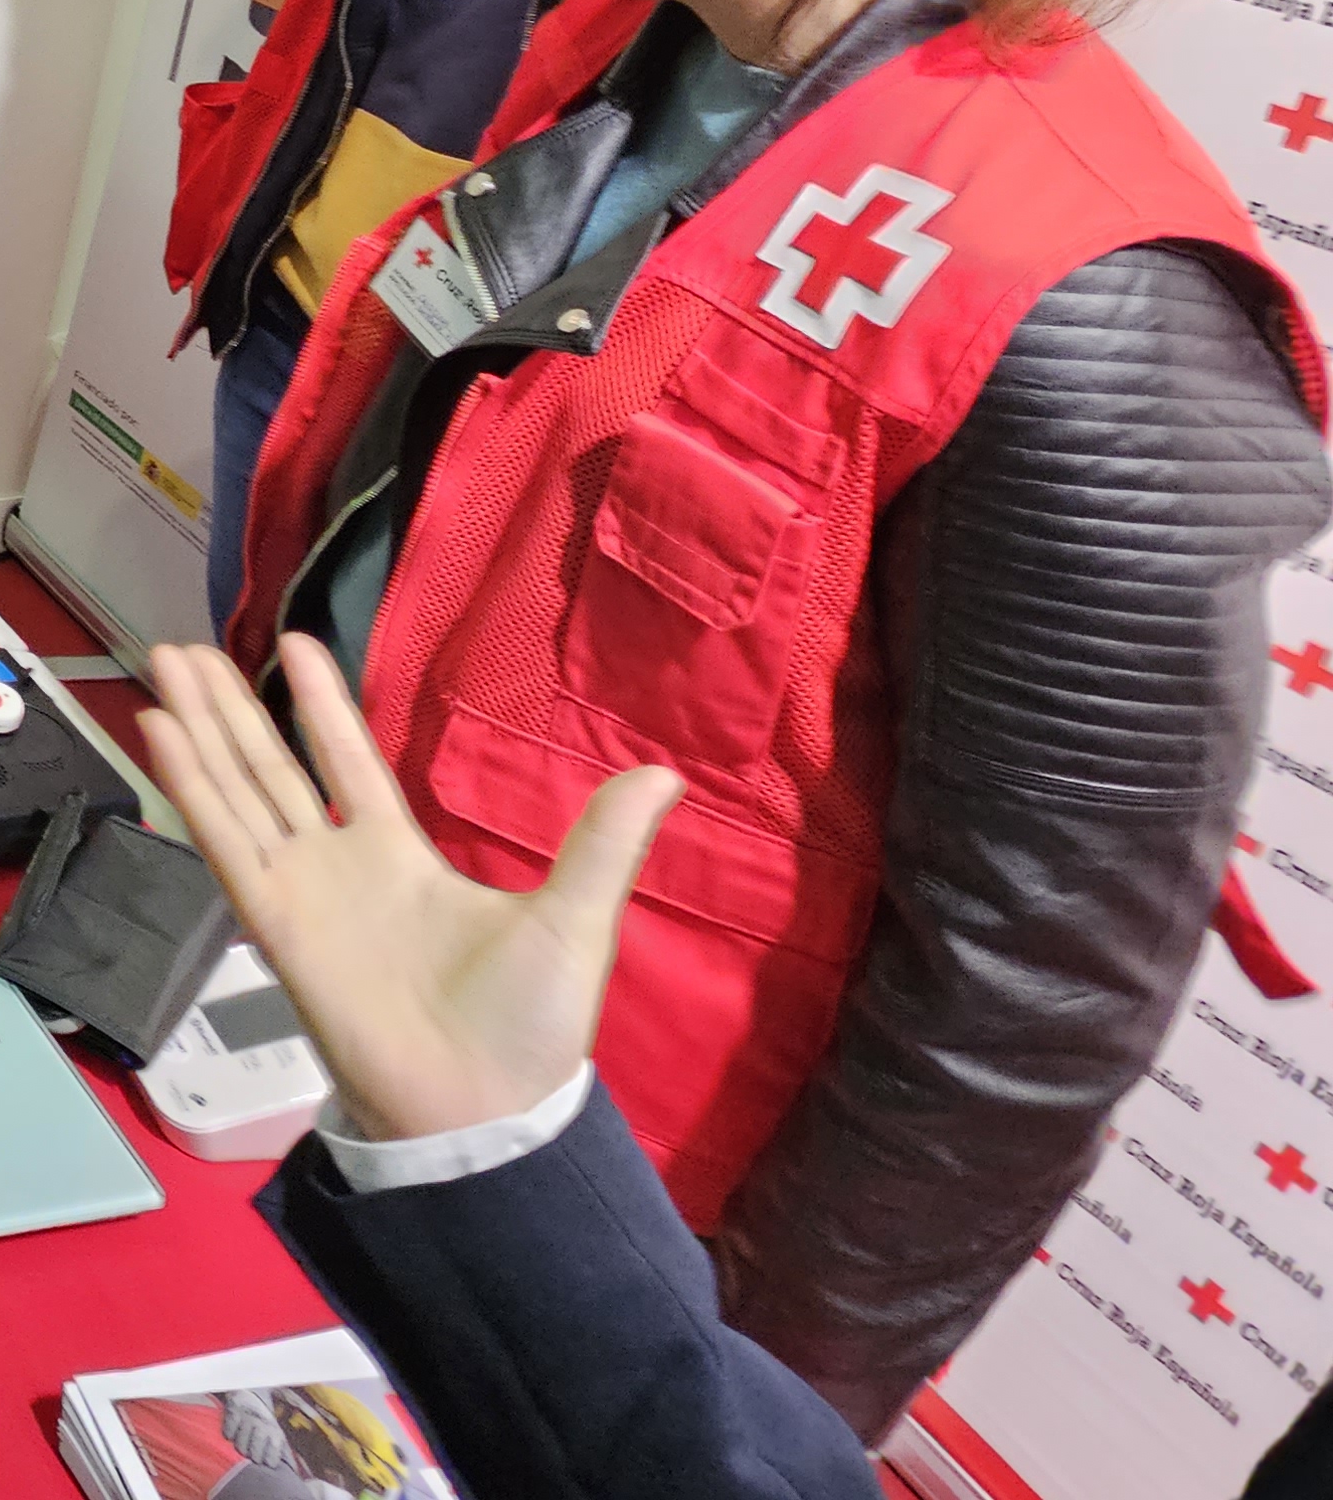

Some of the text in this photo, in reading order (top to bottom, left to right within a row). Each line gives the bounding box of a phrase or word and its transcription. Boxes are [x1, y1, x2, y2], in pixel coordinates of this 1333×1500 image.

[435, 268, 464, 301] Cruz
[1193, 999, 1306, 1087] Cruz Roja
[1122, 1137, 1325, 1300] Cruz Roja Española
[1055, 1261, 1240, 1427] Cruz Roja Española
[1238, 1322, 1318, 1394] Cruz Ro
